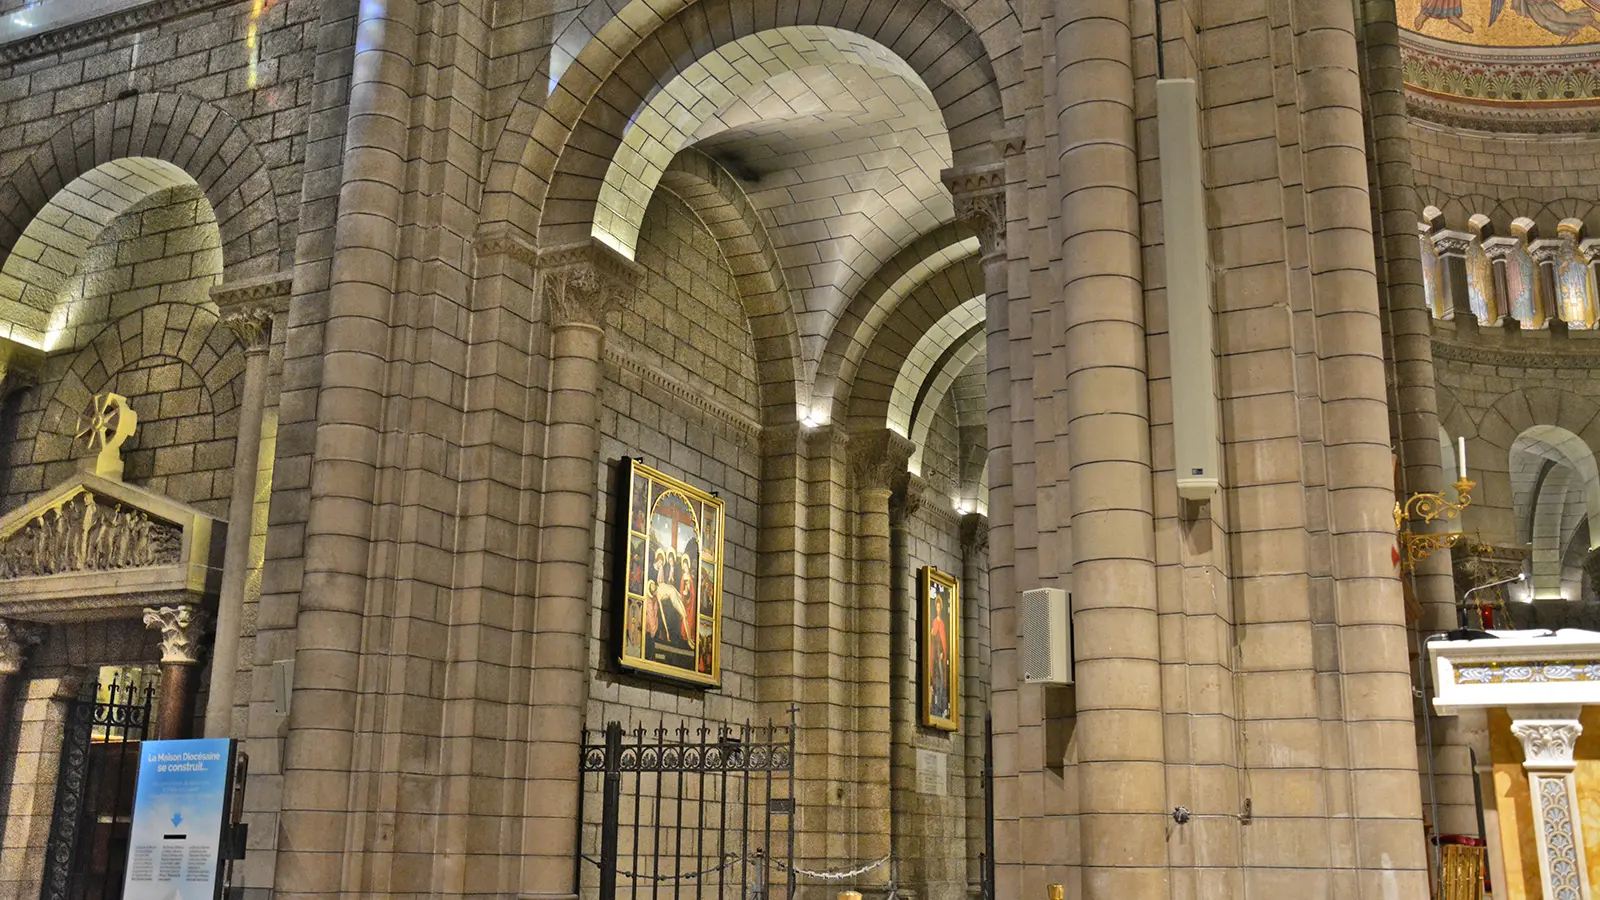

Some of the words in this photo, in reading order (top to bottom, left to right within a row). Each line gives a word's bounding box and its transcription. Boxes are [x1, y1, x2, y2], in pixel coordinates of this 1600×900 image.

[148, 754, 156, 762] La
[158, 753, 182, 762] Maison
[182, 752, 221, 761] Diocésaine
[157, 764, 167, 772] se
